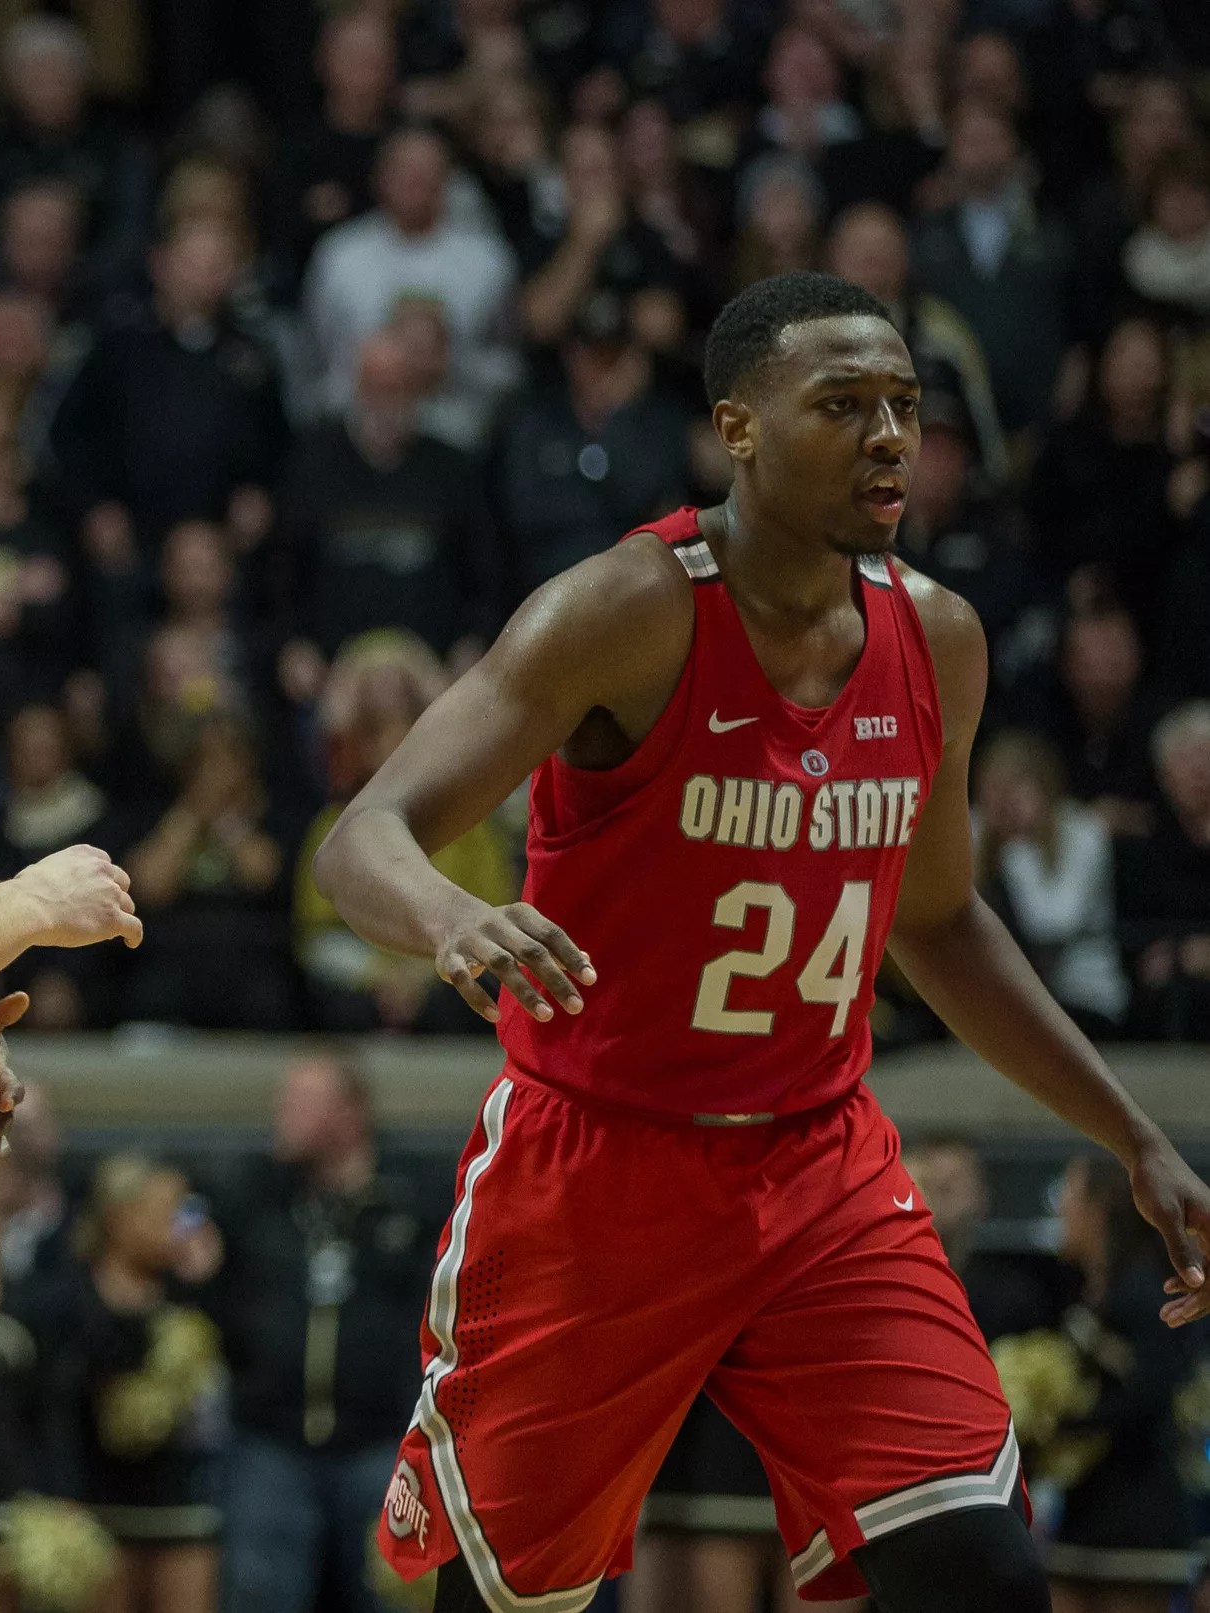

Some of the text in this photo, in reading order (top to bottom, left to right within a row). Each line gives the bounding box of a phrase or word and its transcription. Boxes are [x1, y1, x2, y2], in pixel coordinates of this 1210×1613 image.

[679, 773, 921, 852] OHIO STATE
[690, 879, 873, 1039] 24
[394, 1478, 430, 1551] STATE
